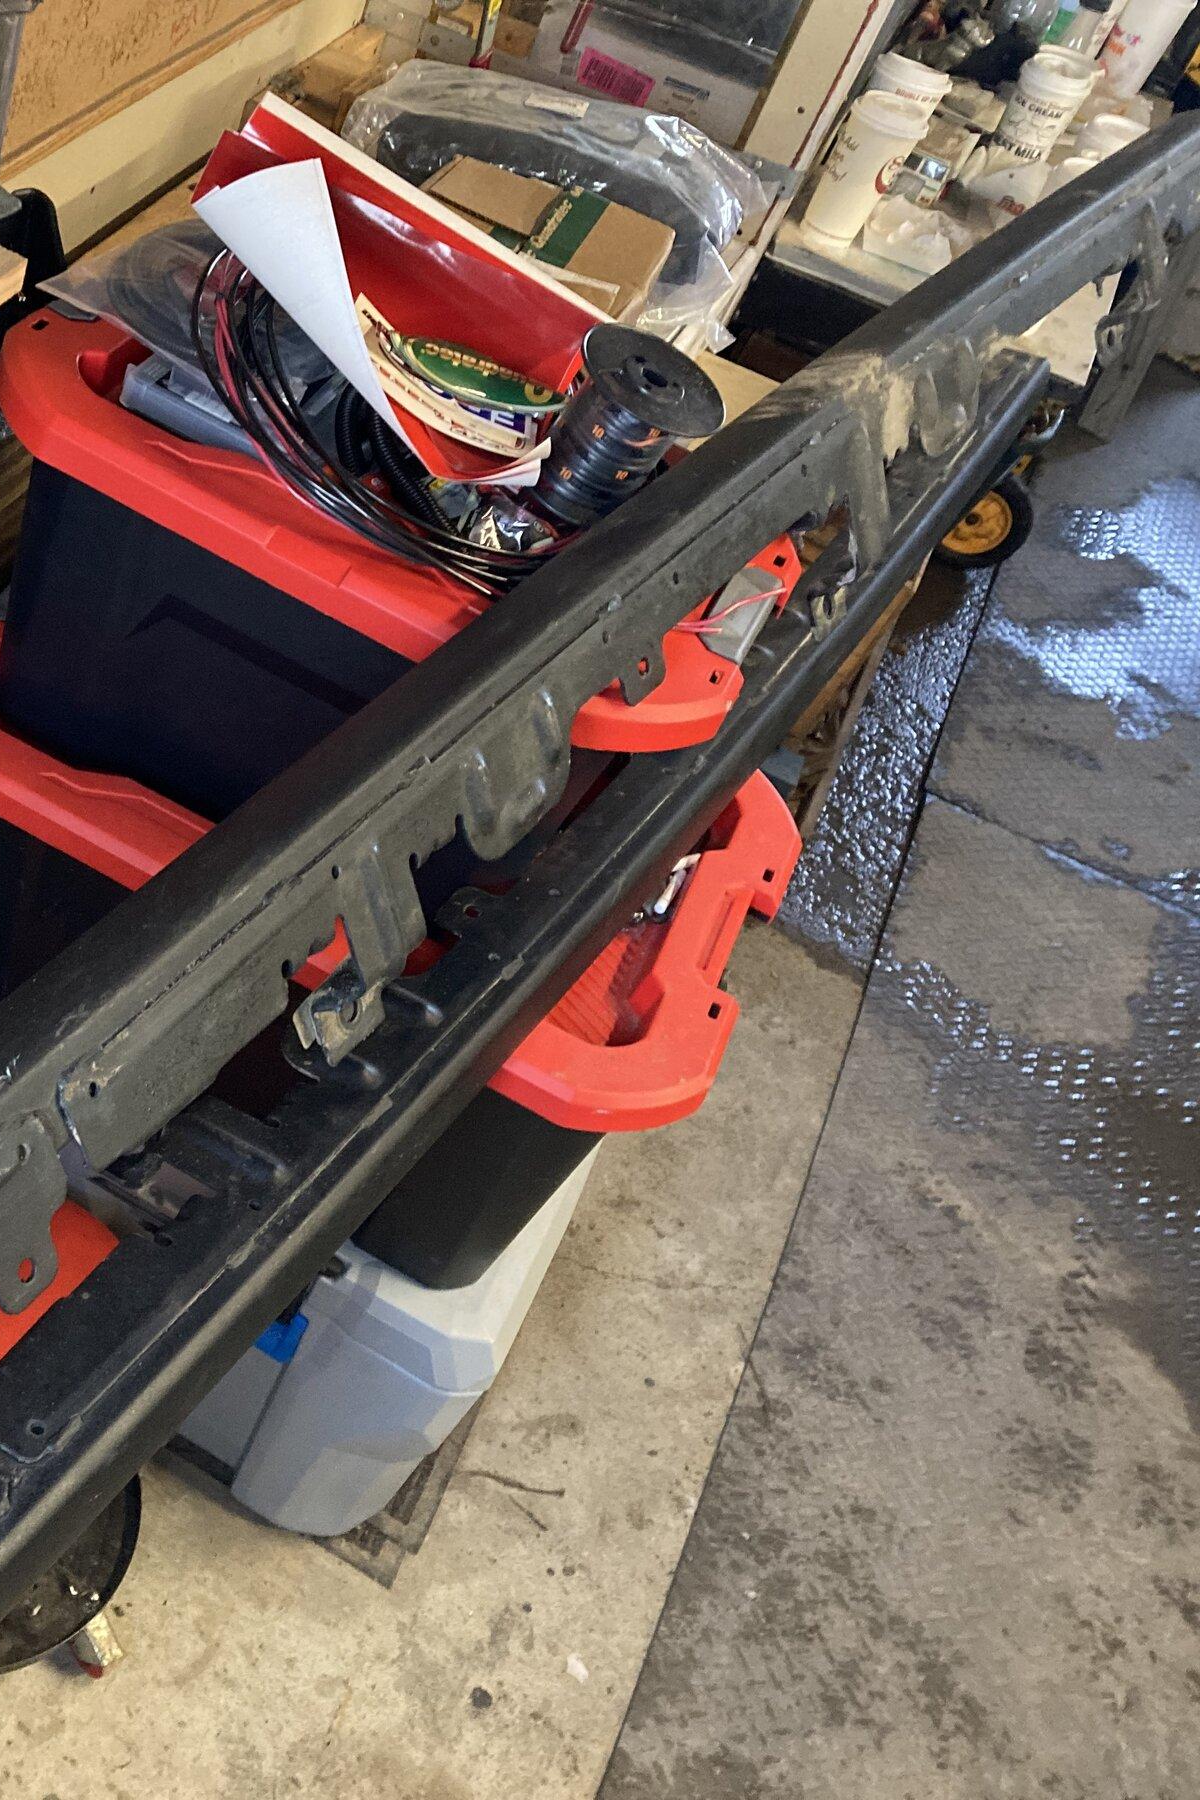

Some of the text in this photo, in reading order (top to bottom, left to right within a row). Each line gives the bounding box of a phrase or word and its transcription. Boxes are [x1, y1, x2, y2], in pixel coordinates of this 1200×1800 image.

[591, 423, 606, 440] 10
[559, 466, 573, 481] 10
[614, 469, 630, 481] 10
